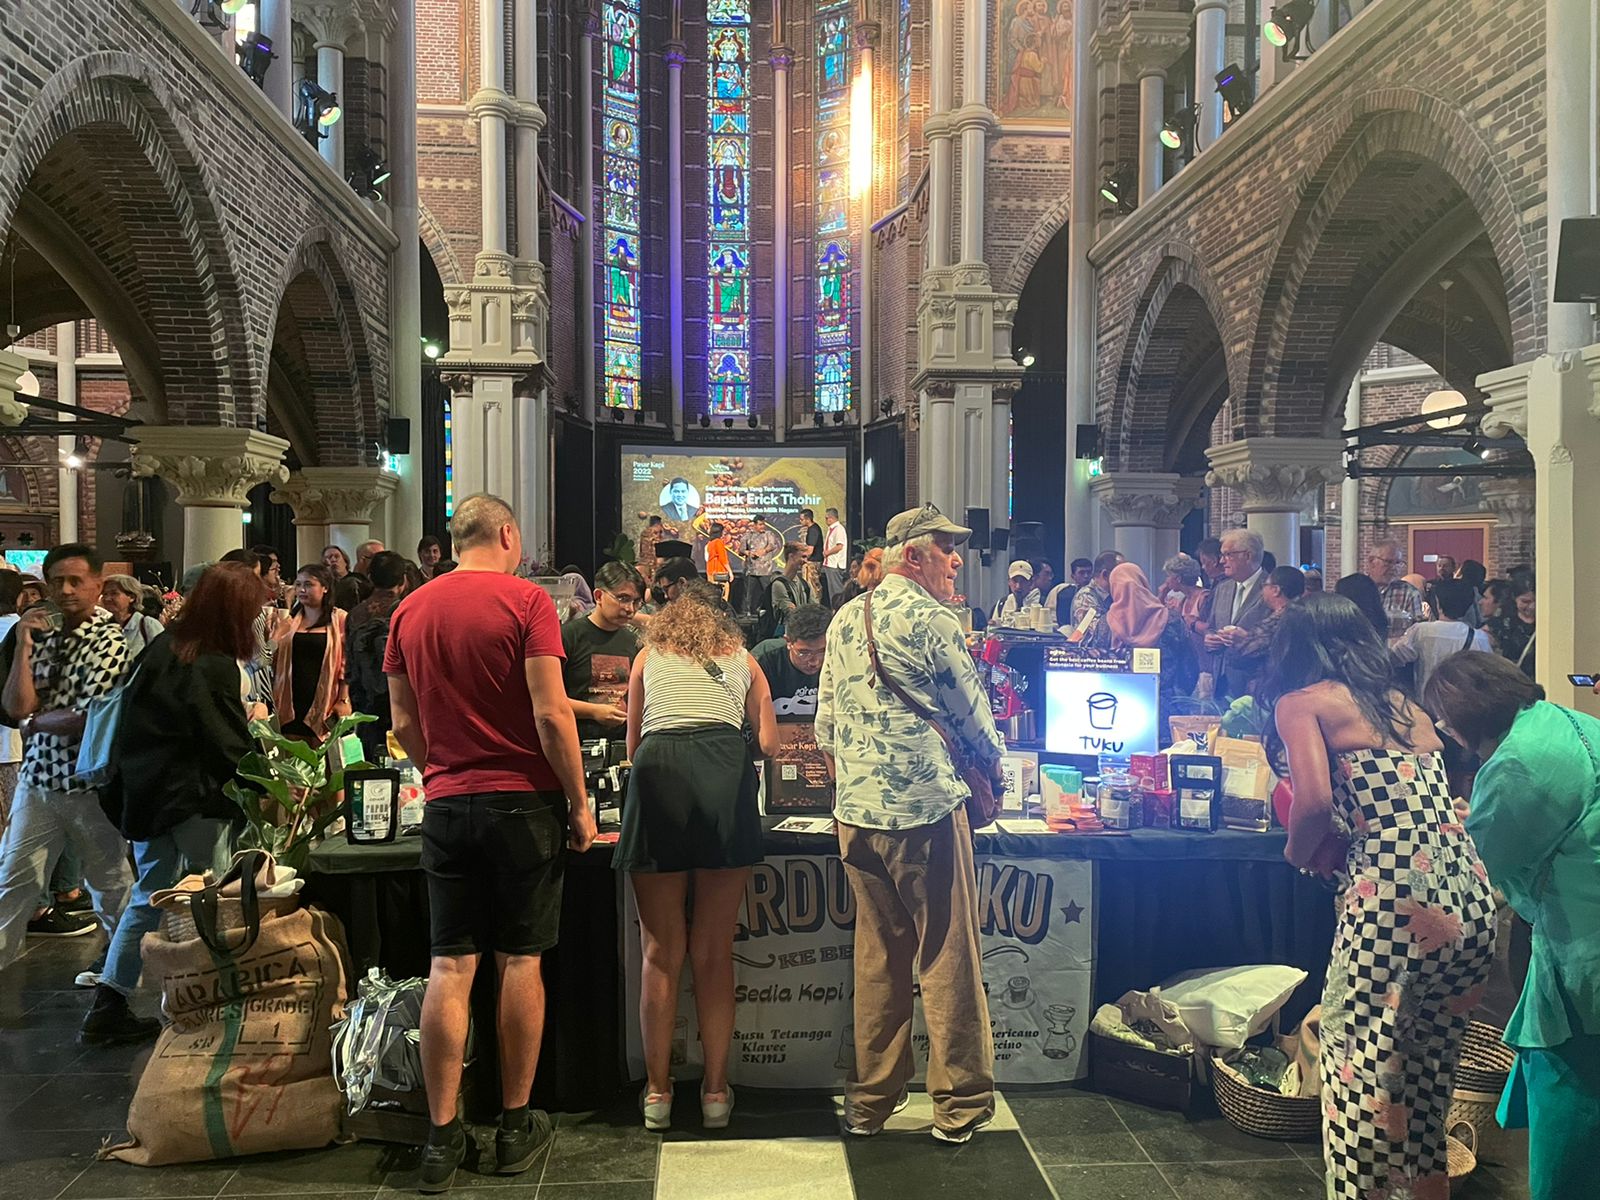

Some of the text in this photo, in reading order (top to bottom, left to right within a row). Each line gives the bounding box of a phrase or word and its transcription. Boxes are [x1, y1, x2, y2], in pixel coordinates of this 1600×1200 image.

[705, 493, 822, 508] Bapak Erick Thohir
[779, 742, 798, 750] asar
[1079, 736, 1124, 753] TUKU
[733, 857, 1054, 945] RDU KU
[778, 944, 854, 970] KE BE
[735, 982, 844, 1005] Sedia Kopi
[250, 998, 311, 1015] GRADE
[273, 1021, 281, 1038] 1
[733, 1029, 832, 1041] Susu Tetangga
[742, 1054, 787, 1064] SKMJ
